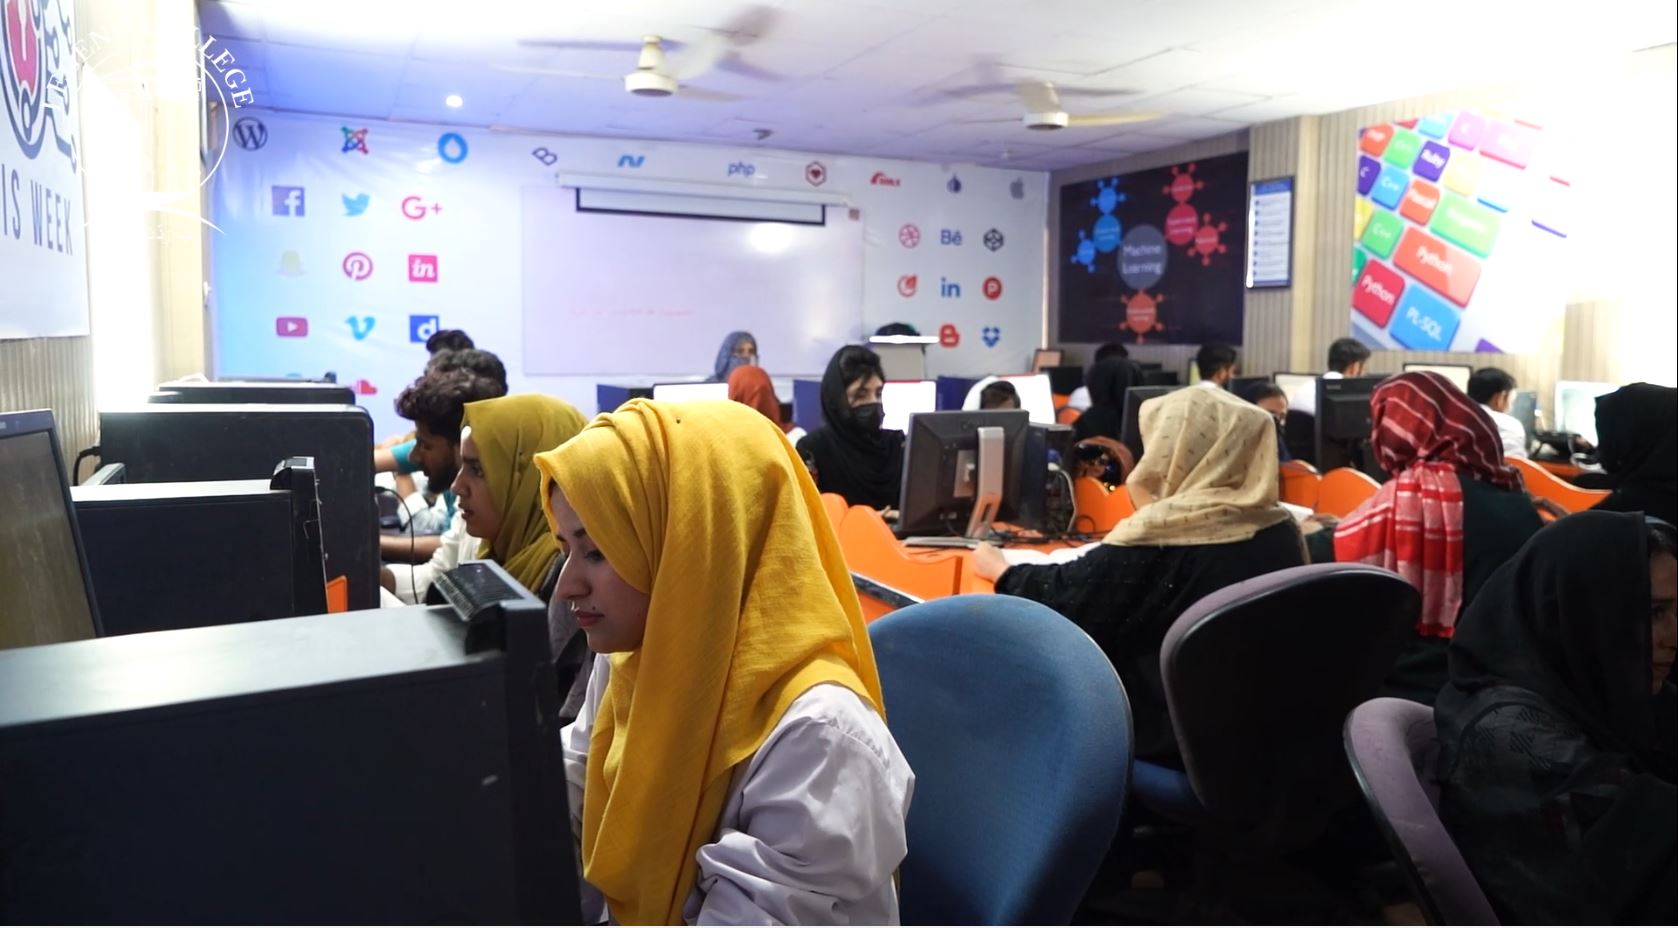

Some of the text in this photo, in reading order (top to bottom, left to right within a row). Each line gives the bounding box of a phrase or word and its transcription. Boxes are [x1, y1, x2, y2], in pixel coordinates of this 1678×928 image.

[728, 162, 755, 177] php
[30, 179, 73, 256] WEEK
[402, 195, 443, 220] G+
[1122, 244, 1161, 257] Machine
[1122, 261, 1161, 276] Learning
[941, 276, 960, 299] in
[1361, 274, 1396, 306] Python
